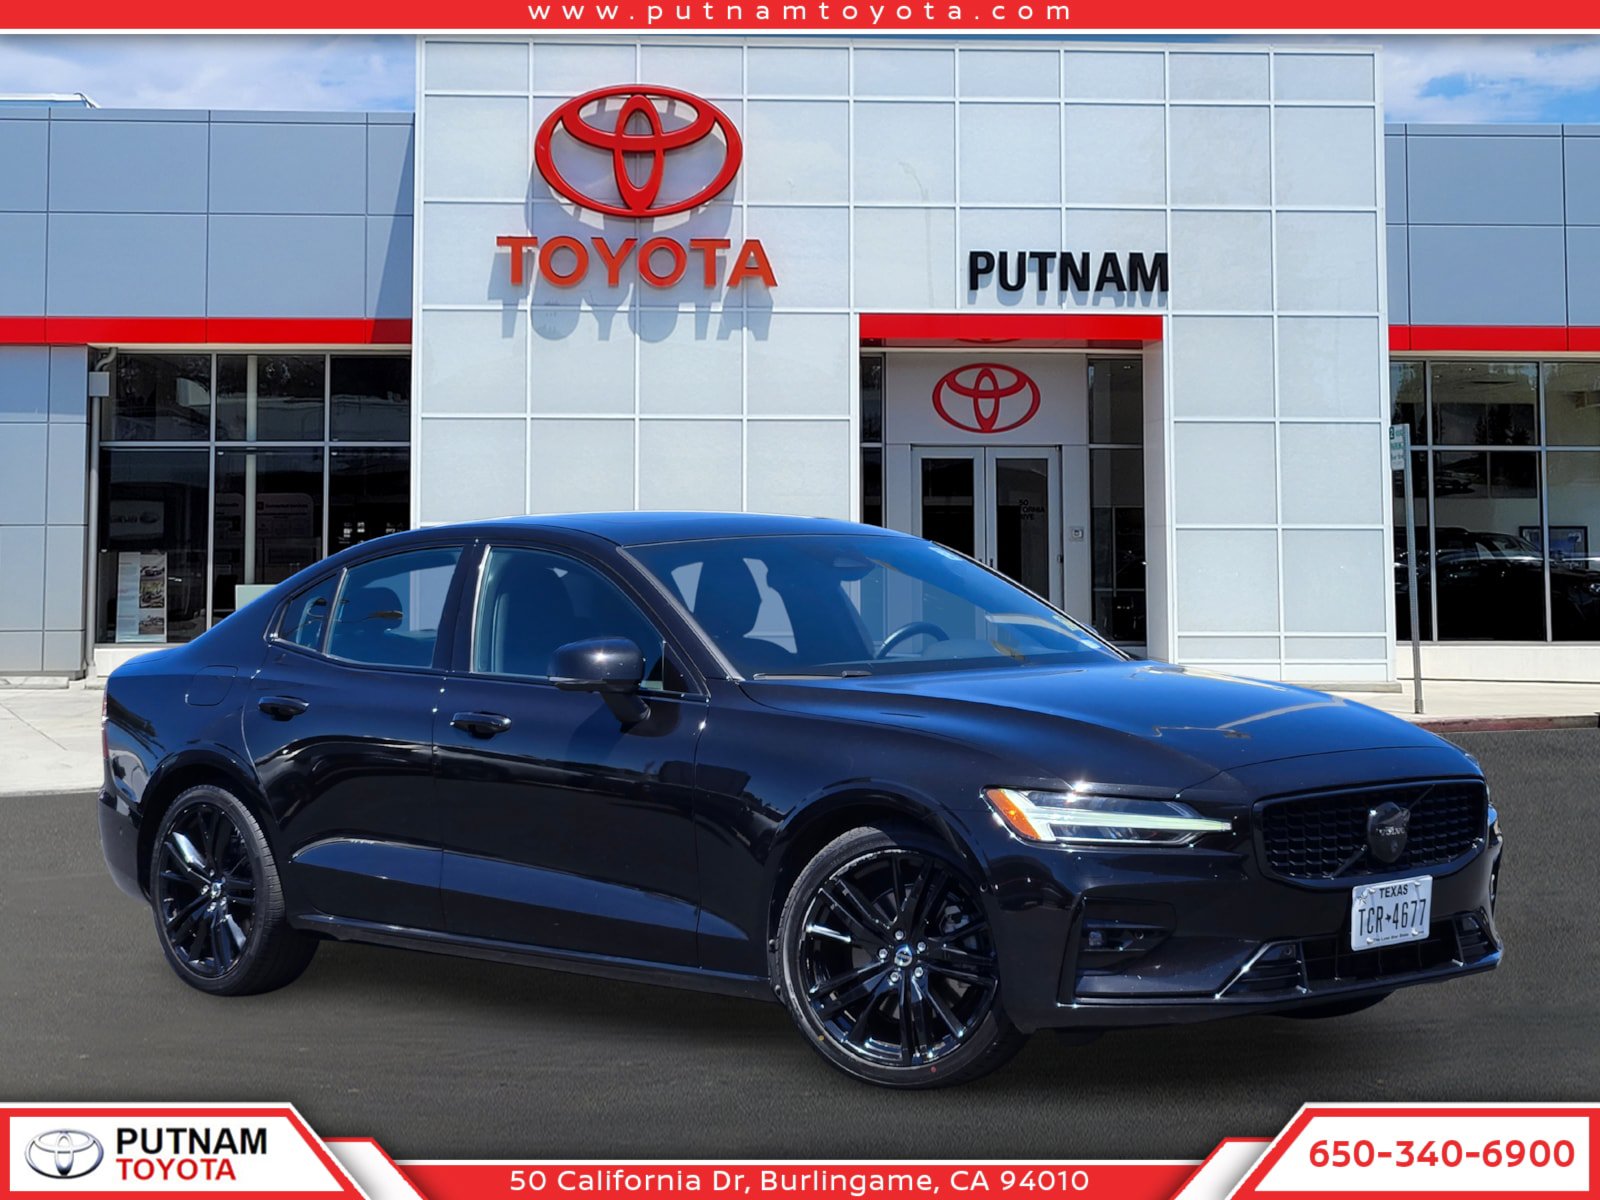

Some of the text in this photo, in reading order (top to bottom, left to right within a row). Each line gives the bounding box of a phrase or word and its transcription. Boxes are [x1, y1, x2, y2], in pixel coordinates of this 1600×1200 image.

[496, 236, 778, 288] TOYOTA
[969, 251, 1169, 292] PUTNAM
[1379, 884, 1408, 899] TEXAS
